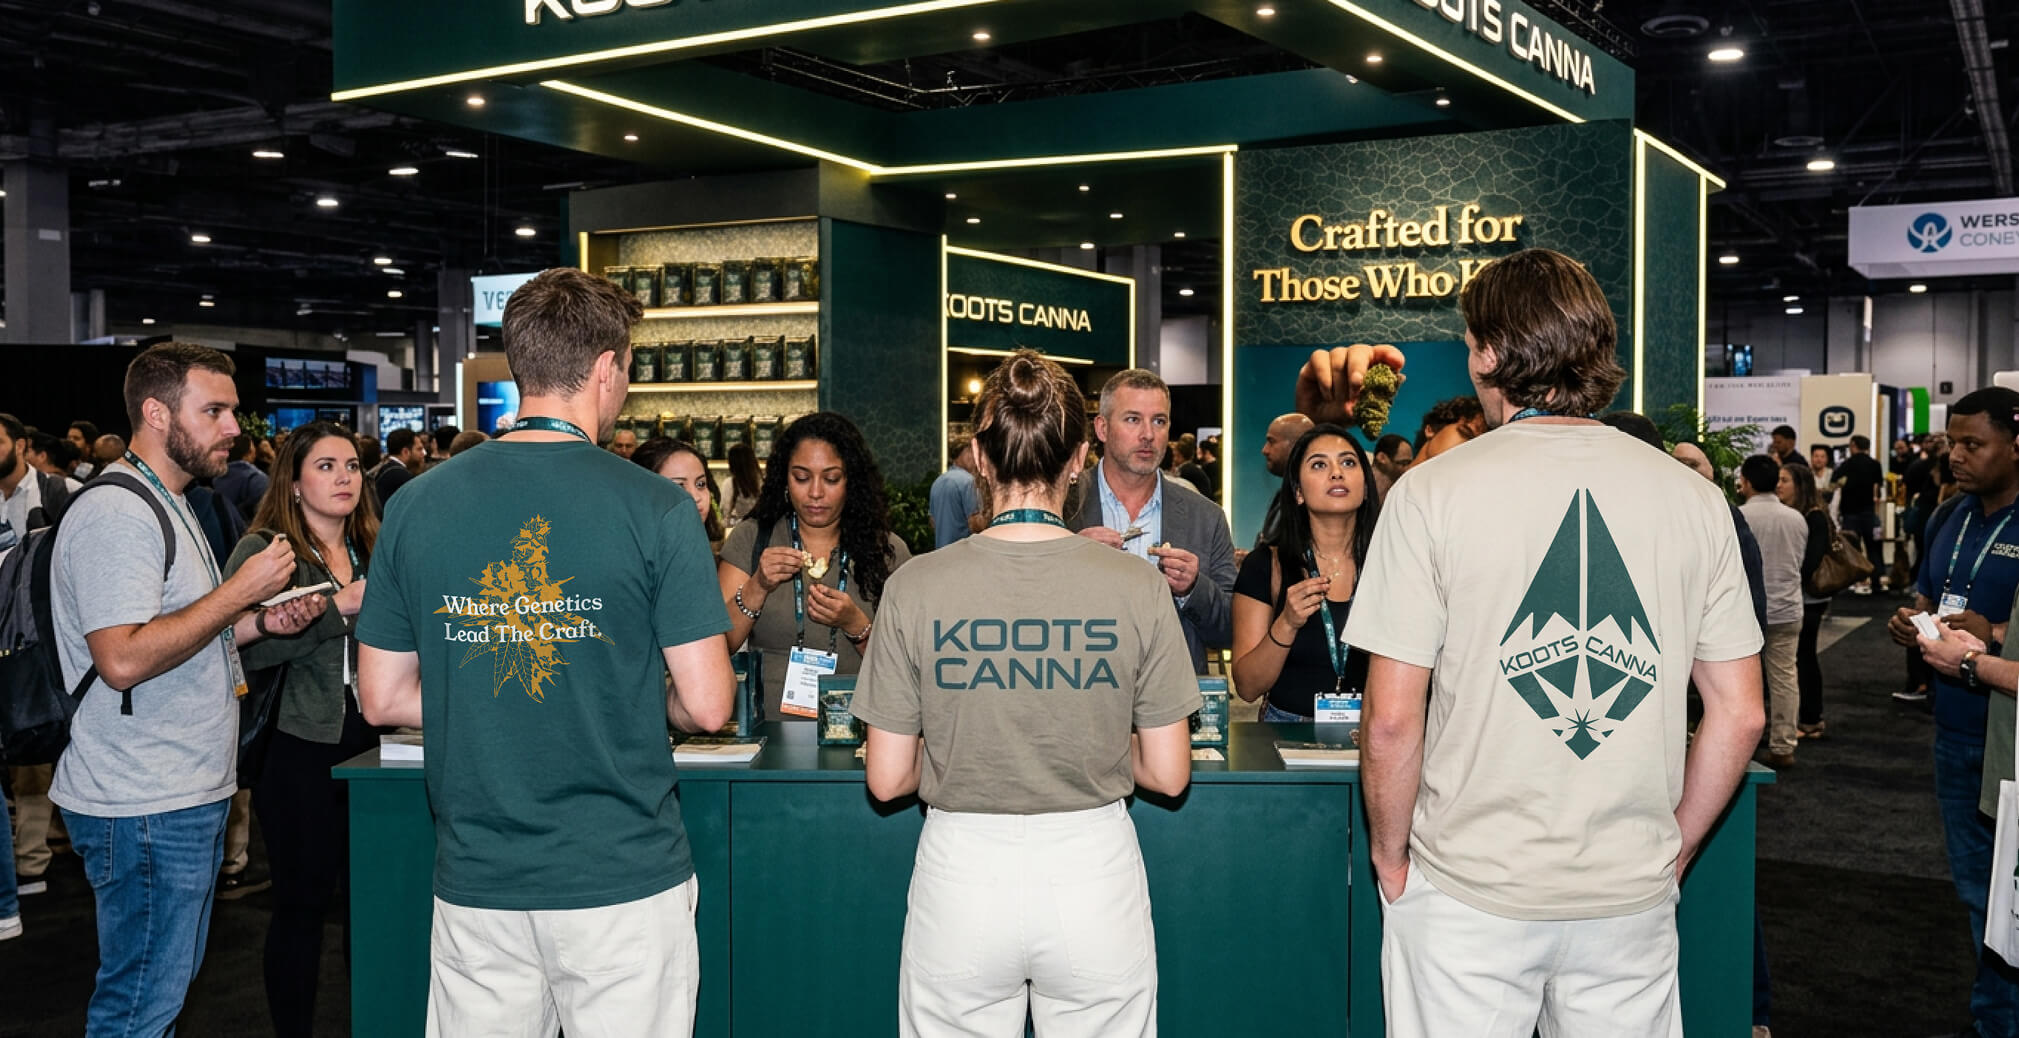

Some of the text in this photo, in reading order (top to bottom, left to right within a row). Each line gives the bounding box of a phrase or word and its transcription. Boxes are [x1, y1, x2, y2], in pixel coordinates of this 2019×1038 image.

[1510, 12, 1596, 95] CANNA
[1290, 202, 1523, 252] Crafted for
[1252, 267, 1361, 303] Those
[1363, 262, 1452, 299] Who
[1019, 303, 1092, 333] CANNA
[442, 594, 603, 616] Where Genetics
[443, 619, 602, 643] Lead The Craft.
[933, 619, 1119, 652] KOOTS
[934, 658, 1120, 690] CANNA
[1499, 635, 1658, 682] KOOTS CANNA
